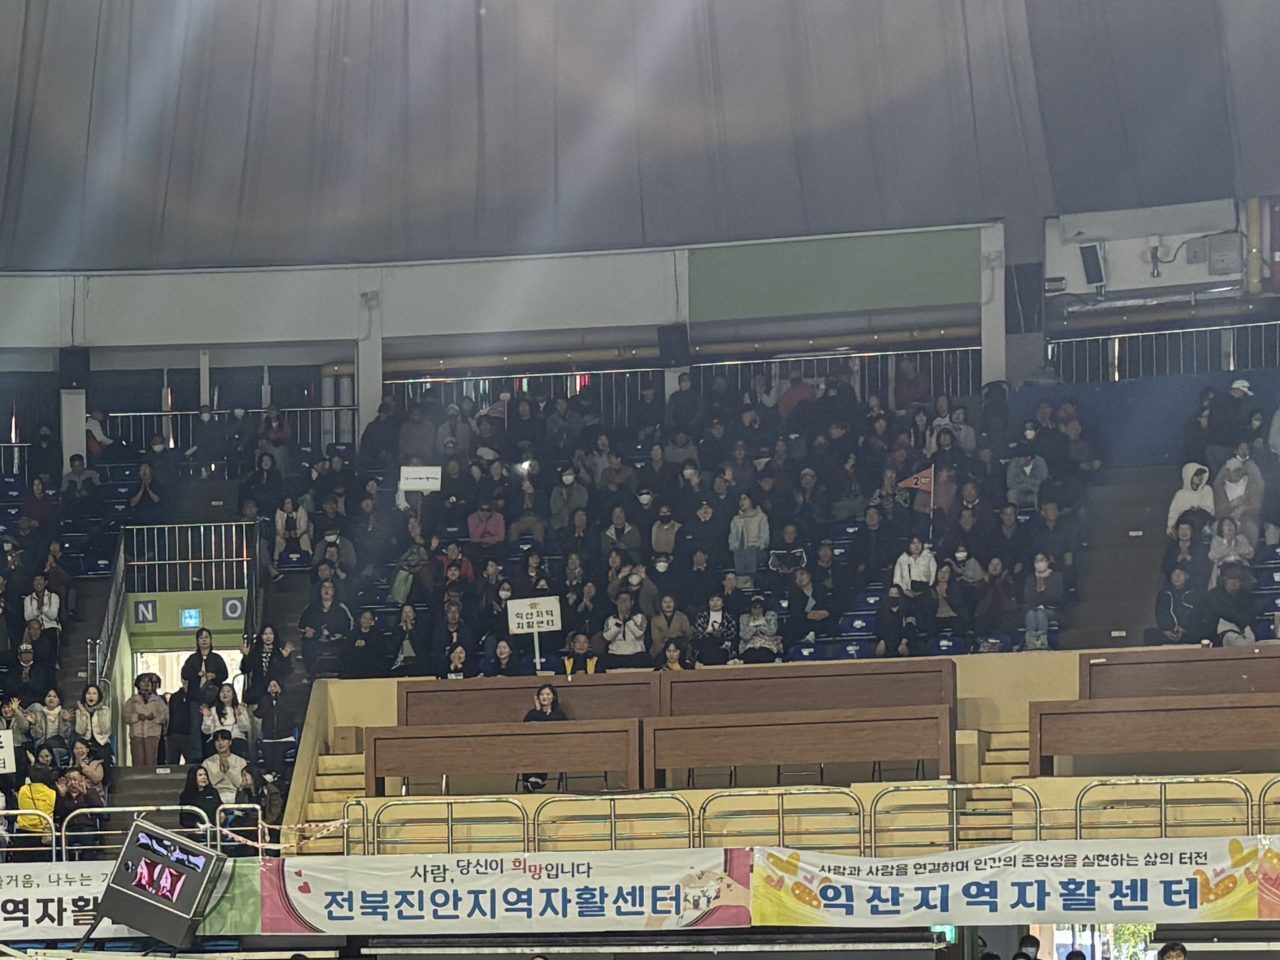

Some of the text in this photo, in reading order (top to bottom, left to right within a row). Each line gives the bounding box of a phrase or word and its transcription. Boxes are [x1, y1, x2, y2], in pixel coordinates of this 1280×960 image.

[138, 603, 153, 621] N
[225, 600, 242, 618] O
[456, 859, 504, 876] 당신이
[511, 858, 593, 880] 희망입니다
[974, 855, 1017, 870] 인간의
[1021, 854, 1077, 868] 존엄성을
[1082, 853, 1139, 867] 실현하는
[1144, 852, 1173, 866] 삶의
[1179, 852, 1208, 866] 터전
[49, 873, 92, 887] 나누는
[324, 884, 682, 922] 전북진안지역자활센터
[819, 878, 1200, 915] 익산지역자활센터
